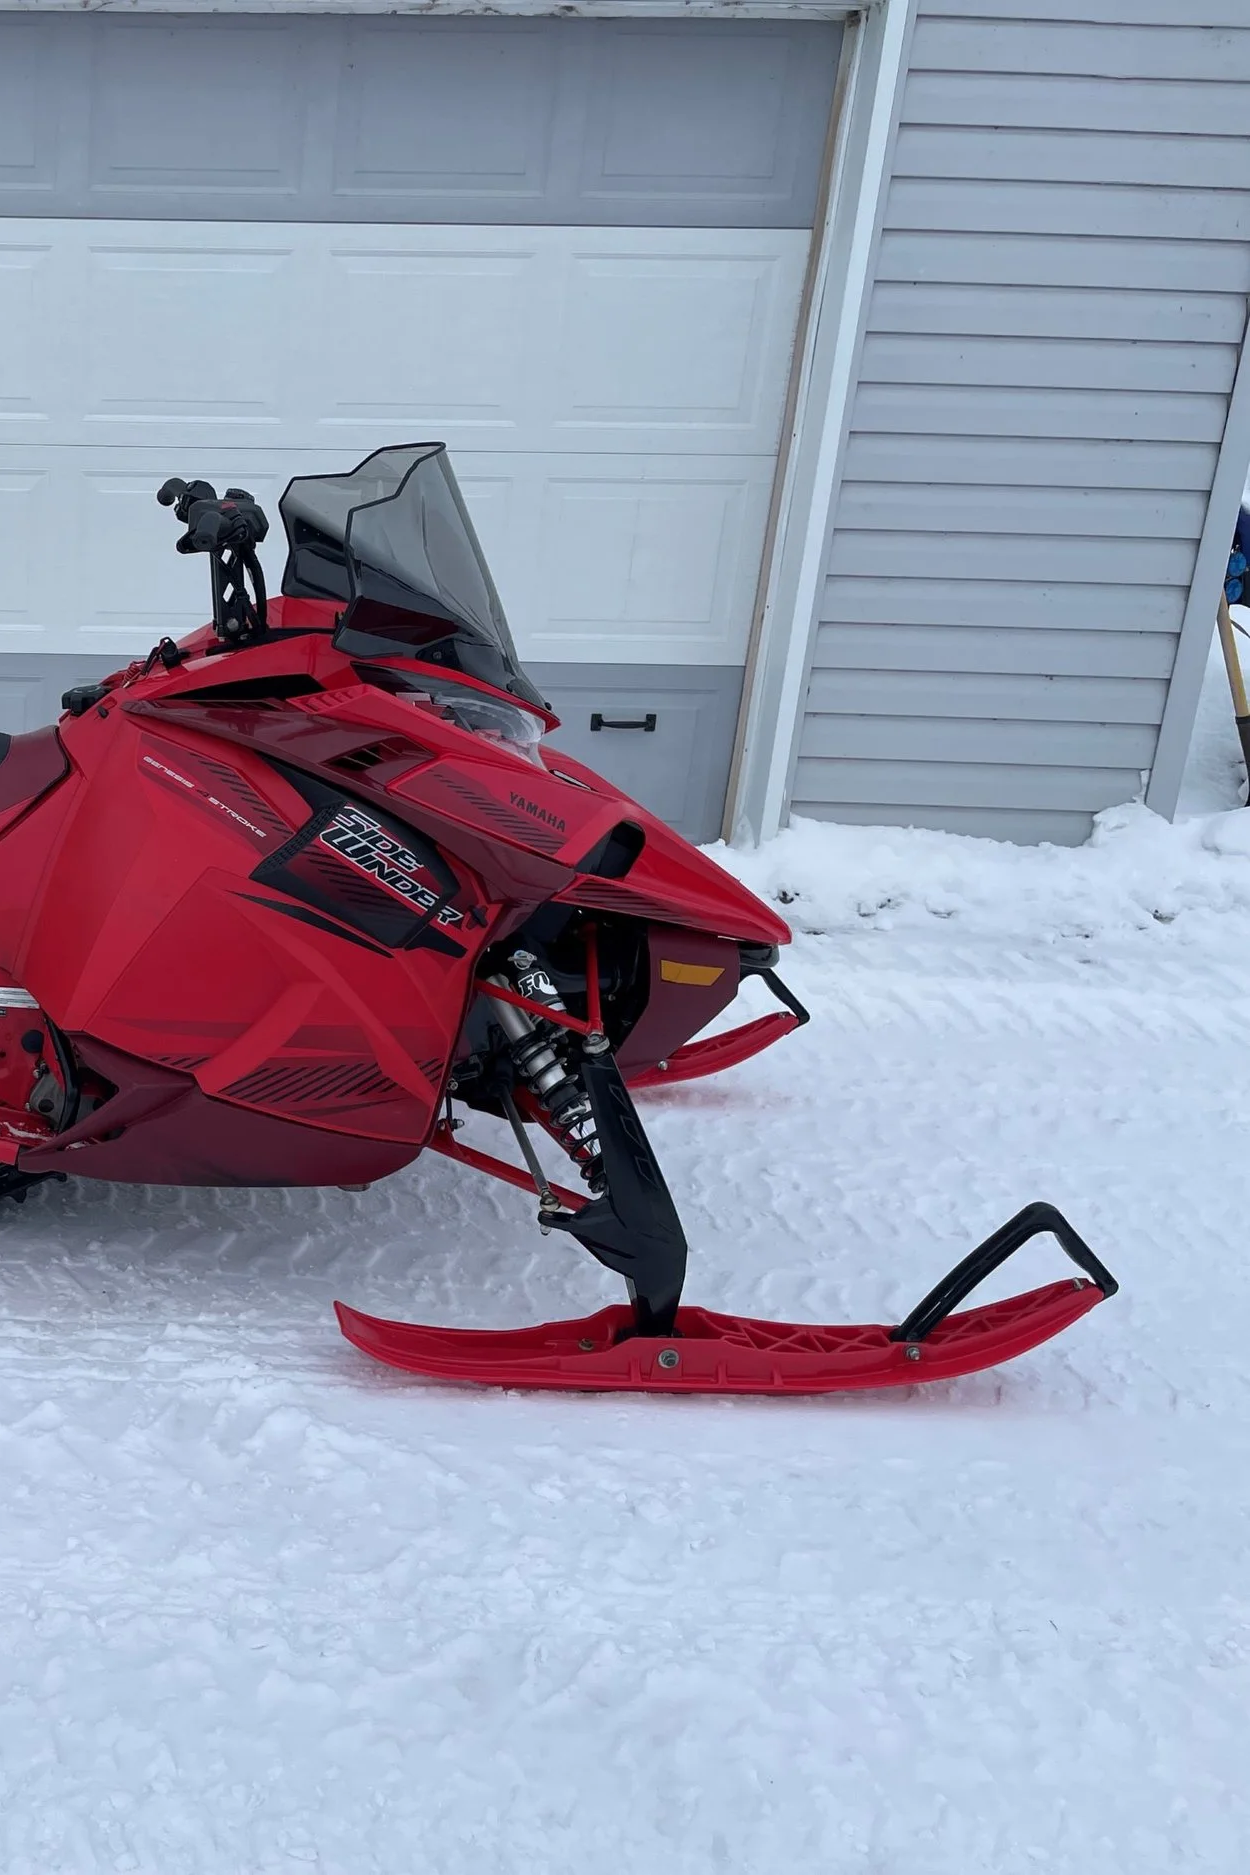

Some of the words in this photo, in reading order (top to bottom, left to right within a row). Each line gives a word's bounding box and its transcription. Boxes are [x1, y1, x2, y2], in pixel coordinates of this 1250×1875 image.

[332, 805, 425, 873] SIDE
[510, 791, 566, 833] YAMAHA
[319, 825, 464, 926] WINDER
